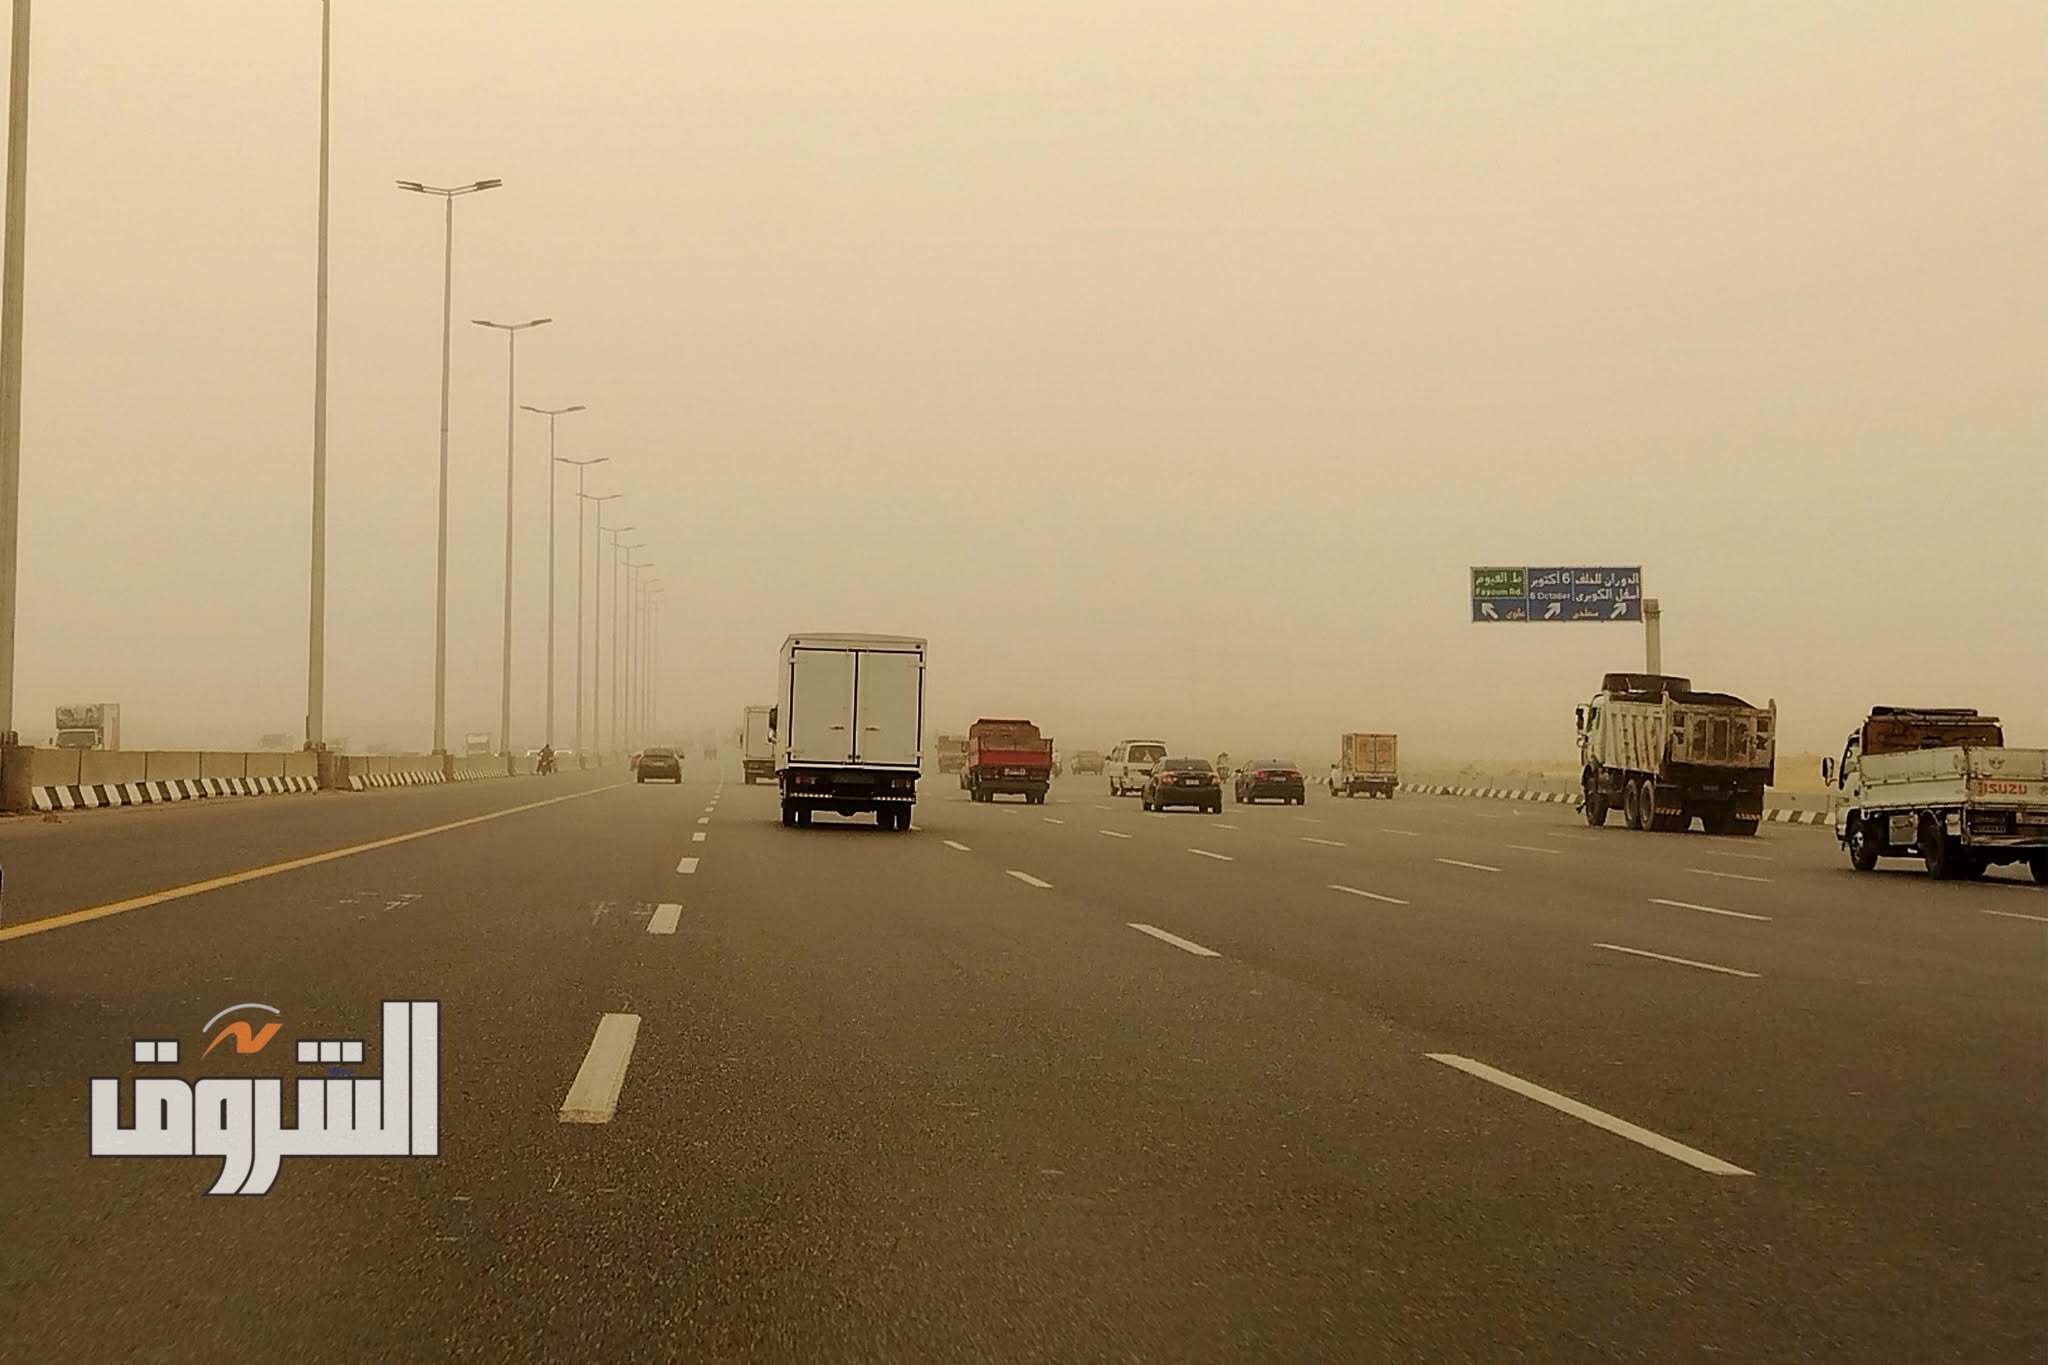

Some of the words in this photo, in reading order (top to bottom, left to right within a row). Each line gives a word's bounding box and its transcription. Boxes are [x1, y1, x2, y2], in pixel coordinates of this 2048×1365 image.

[1561, 571, 1571, 585] 6
[1604, 572, 1639, 587] الدوران
[1537, 591, 1570, 601] October
[1983, 782, 2028, 796] ISUZU
